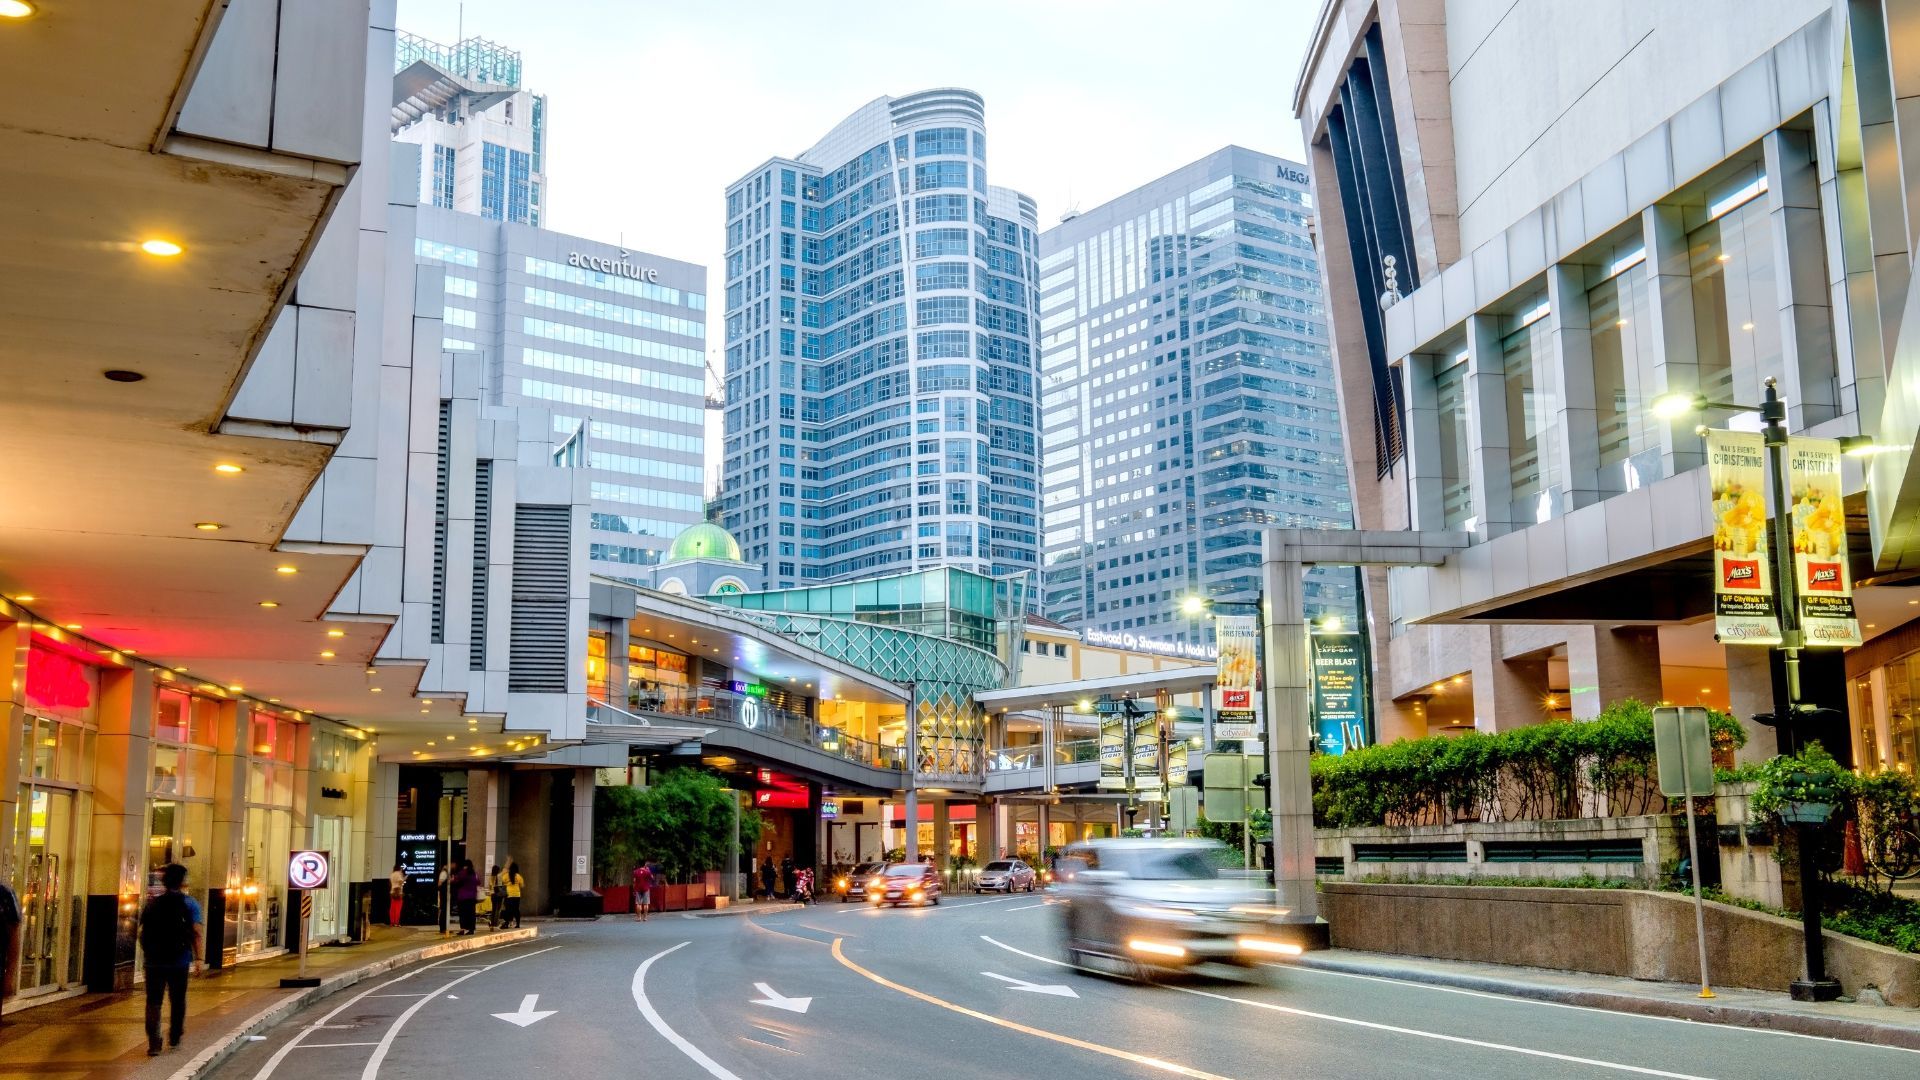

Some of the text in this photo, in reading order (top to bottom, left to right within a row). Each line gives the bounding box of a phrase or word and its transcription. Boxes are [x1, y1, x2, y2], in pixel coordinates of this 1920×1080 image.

[568, 251, 658, 283] accenture
[1713, 453, 1762, 468] CHRISTENING
[1726, 566, 1752, 583] Max's
[1810, 569, 1836, 584] Max's
[1734, 595, 1760, 604] CityWalk
[1219, 630, 1255, 638] CHRISTENING
[1726, 624, 1770, 640] citywalk
[1813, 628, 1854, 642] citywalk
[1087, 627, 1121, 645] Eastwood
[1123, 634, 1138, 649] City
[1139, 635, 1175, 652] Showroom
[1177, 641, 1183, 653] &
[1185, 643, 1205, 657] Model
[1316, 658, 1357, 666] BEER BLAST
[1101, 752, 1121, 760] LIGHT
[1135, 752, 1156, 760] LIGHT
[302, 859, 319, 880] P
